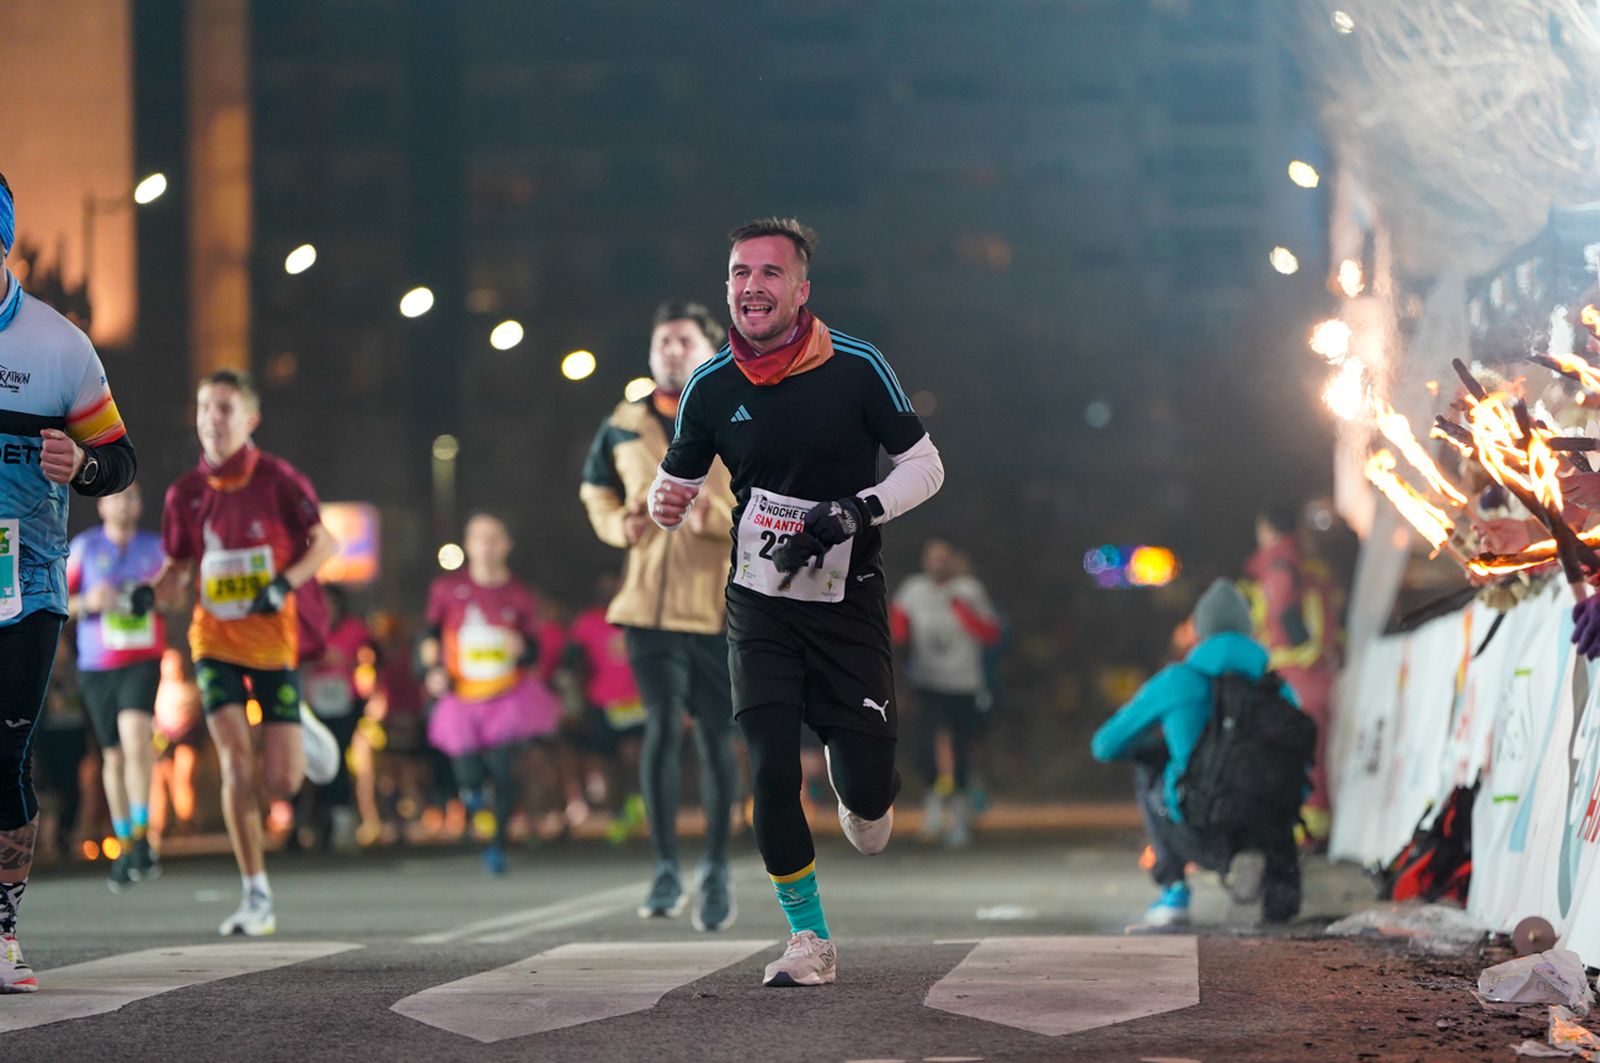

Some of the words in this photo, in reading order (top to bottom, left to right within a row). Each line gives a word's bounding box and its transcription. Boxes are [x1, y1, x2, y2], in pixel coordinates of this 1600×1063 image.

[766, 504, 799, 520] NOCHE
[753, 513, 773, 528] SAN
[773, 518, 804, 533] ANTÓ
